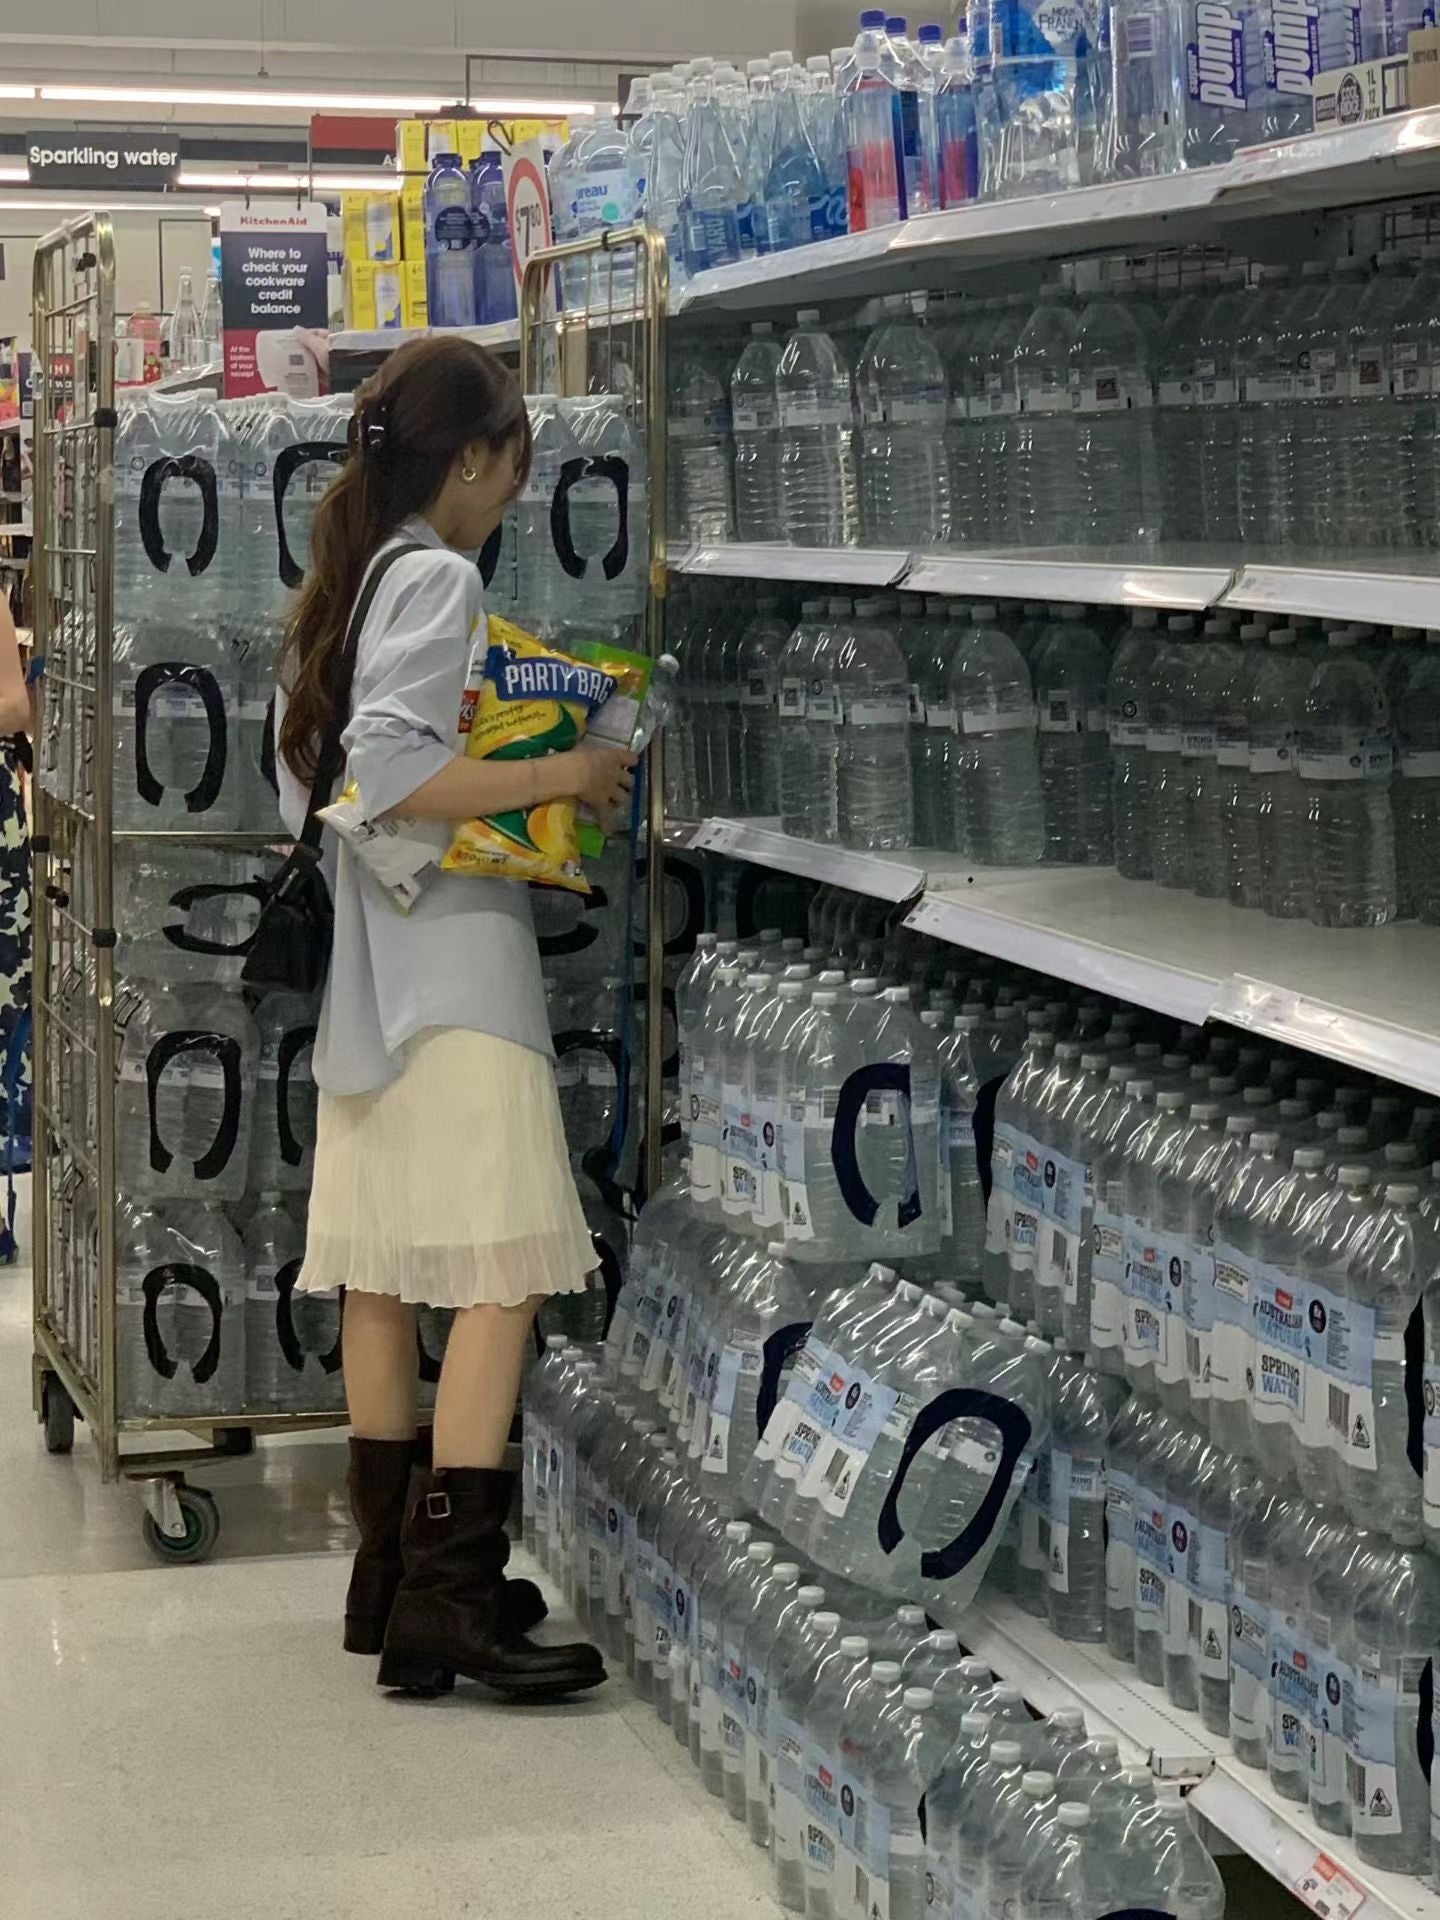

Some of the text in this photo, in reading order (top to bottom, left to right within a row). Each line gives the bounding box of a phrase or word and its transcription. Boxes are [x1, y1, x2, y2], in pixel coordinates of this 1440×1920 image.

[1196, 2, 1248, 111] pump
[30, 145, 178, 169] Sparkling water
[240, 216, 308, 226] KitchenAid
[248, 247, 302, 259] Where to
[241, 261, 309, 275] check your
[245, 276, 306, 287] cookware
[258, 289, 293, 300] credit
[250, 303, 302, 314] balance
[505, 662, 576, 695] PARTY
[577, 668, 614, 705] BAG
[1262, 1354, 1299, 1386] SPRING
